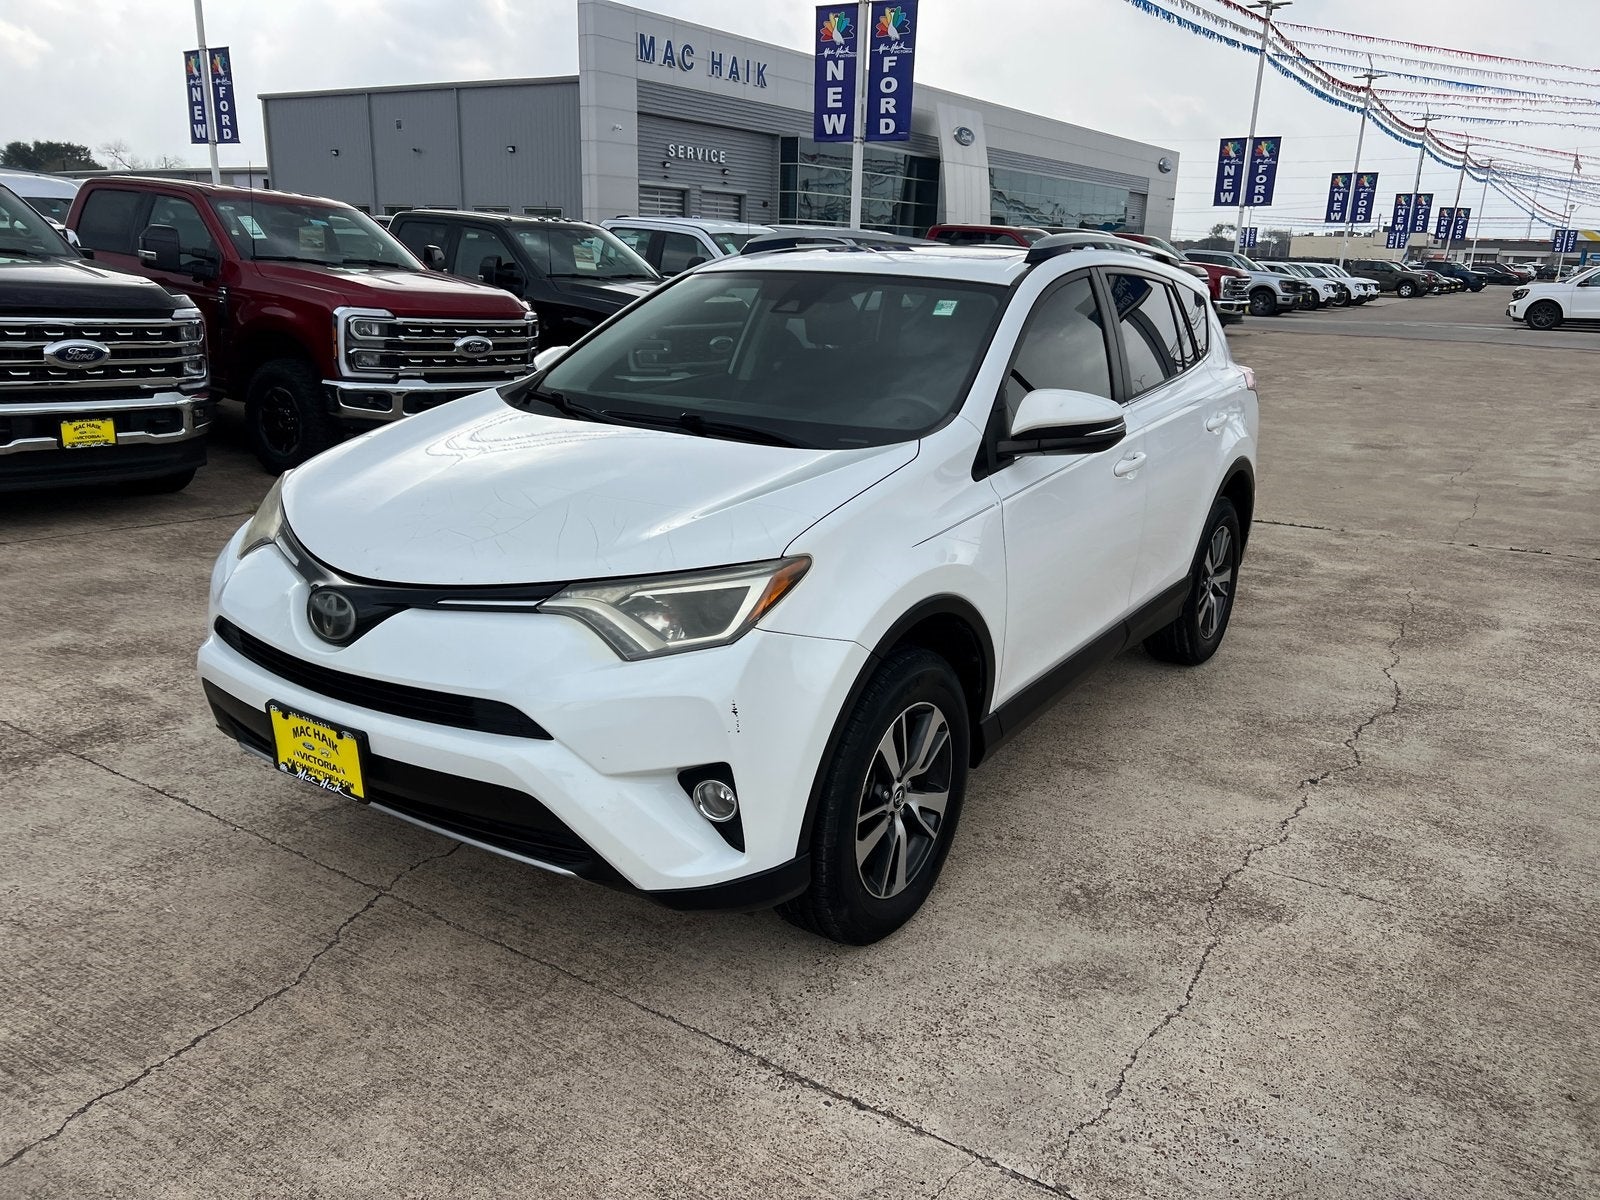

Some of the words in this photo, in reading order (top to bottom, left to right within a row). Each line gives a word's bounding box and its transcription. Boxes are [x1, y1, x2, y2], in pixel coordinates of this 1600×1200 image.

[638, 32, 695, 71] MAC
[710, 50, 768, 88] HAIK
[822, 60, 847, 135] NEW
[879, 55, 898, 135] FORD
[192, 87, 206, 139] NEW
[219, 87, 232, 139] FORD
[668, 143, 727, 164] SERVICE
[1220, 165, 1235, 203] NEW
[1253, 164, 1268, 204] FORD
[1330, 192, 1344, 221] NEW
[1356, 192, 1368, 221] FORD
[1394, 208, 1406, 231] NEW
[1415, 208, 1426, 232] FORD
[1438, 219, 1448, 238] NEW
[1455, 220, 1464, 239] FORD
[65, 347, 95, 360] Ford
[292, 725, 312, 739] MAC
[313, 728, 340, 756] HAIK
[299, 750, 339, 774] VICTORIA
[296, 769, 318, 784] Mac
[319, 778, 343, 793] Haik
